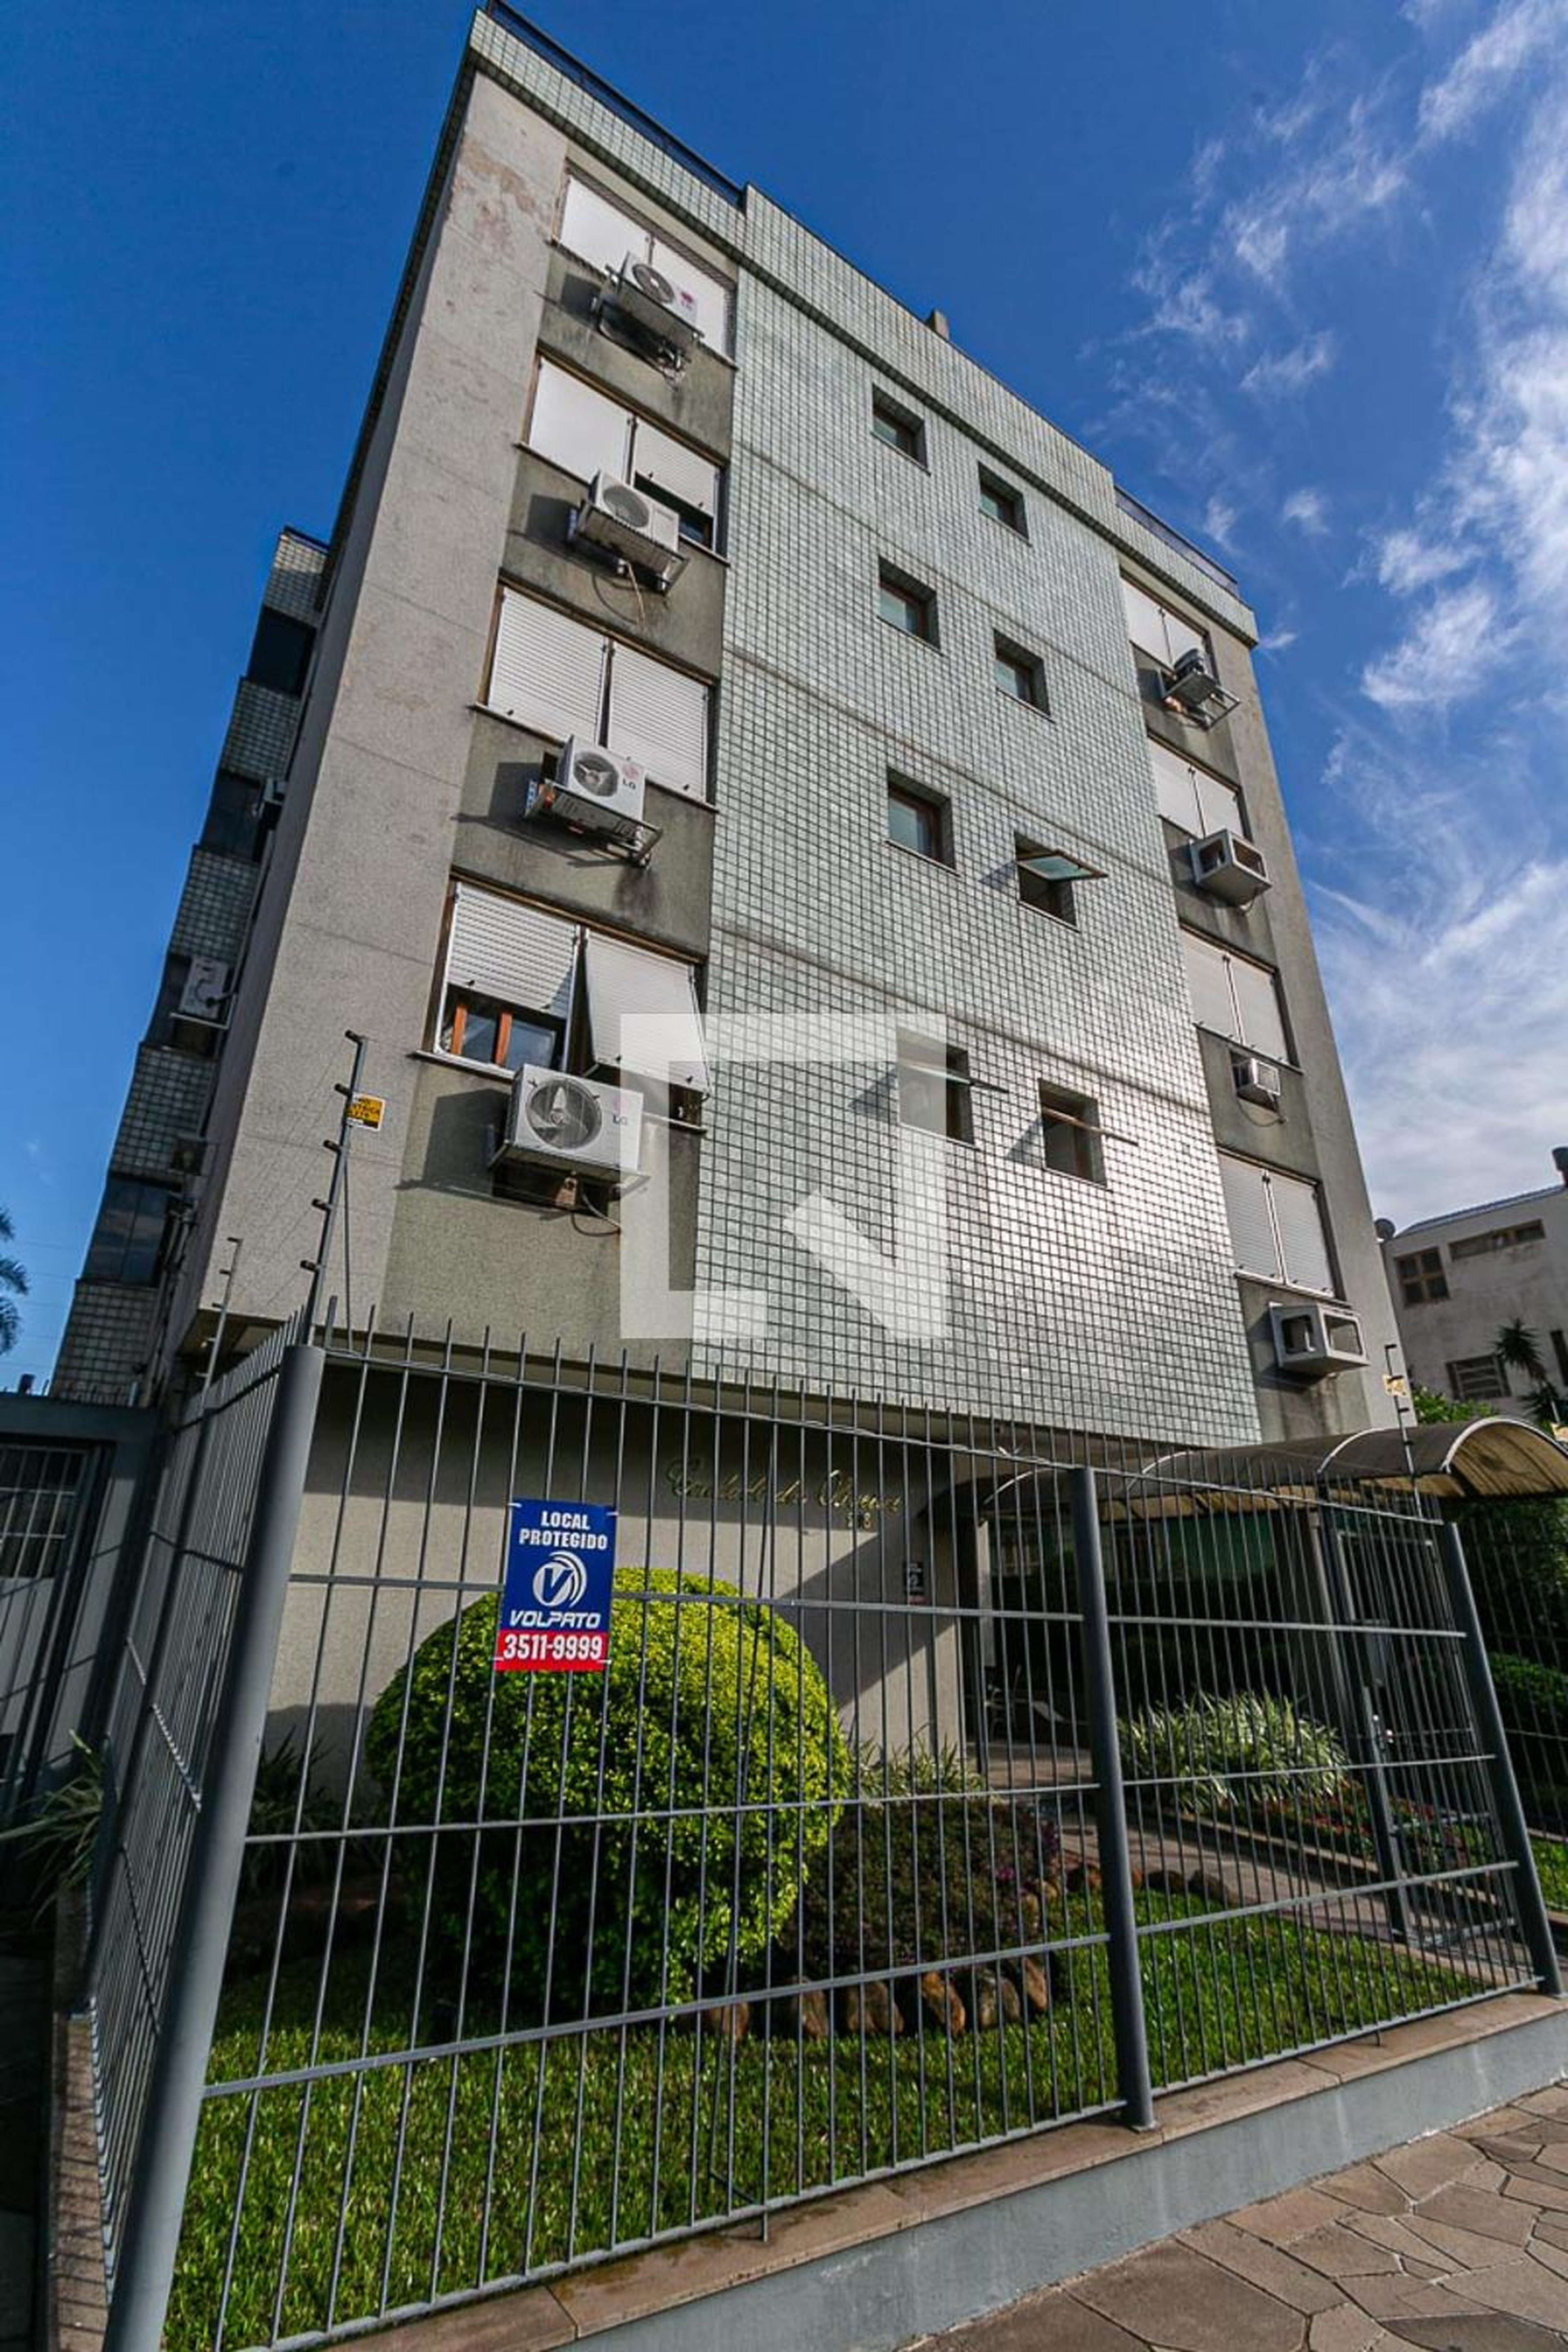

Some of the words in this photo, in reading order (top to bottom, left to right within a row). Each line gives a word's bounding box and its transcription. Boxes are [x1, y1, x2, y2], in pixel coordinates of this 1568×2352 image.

[541, 1511, 590, 1530] LOCAL
[519, 1529, 607, 1549] PROTEGIDO
[510, 1610, 601, 1628] VOLPATO
[503, 1635, 602, 1660] 3511-9999
